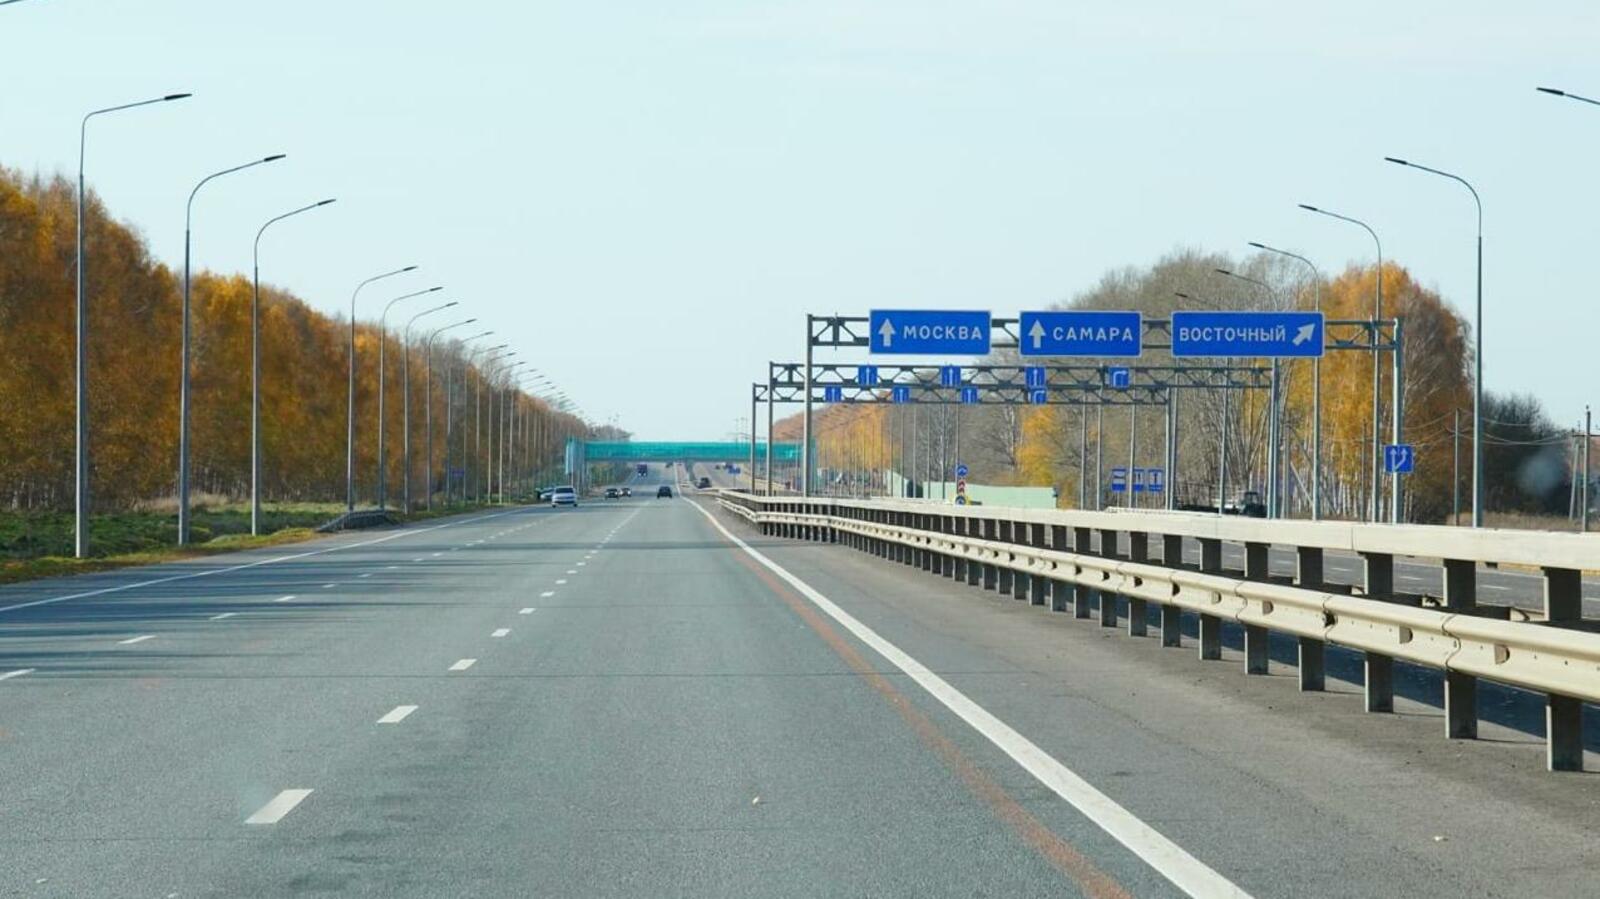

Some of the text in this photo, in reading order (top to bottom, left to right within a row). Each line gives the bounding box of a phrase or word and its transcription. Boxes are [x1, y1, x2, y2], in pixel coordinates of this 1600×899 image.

[903, 326, 983, 341] МОСКВА
[1053, 327, 1134, 341] САМАРА
[1179, 325, 1286, 342] ВОСТОЧНЫЙ
